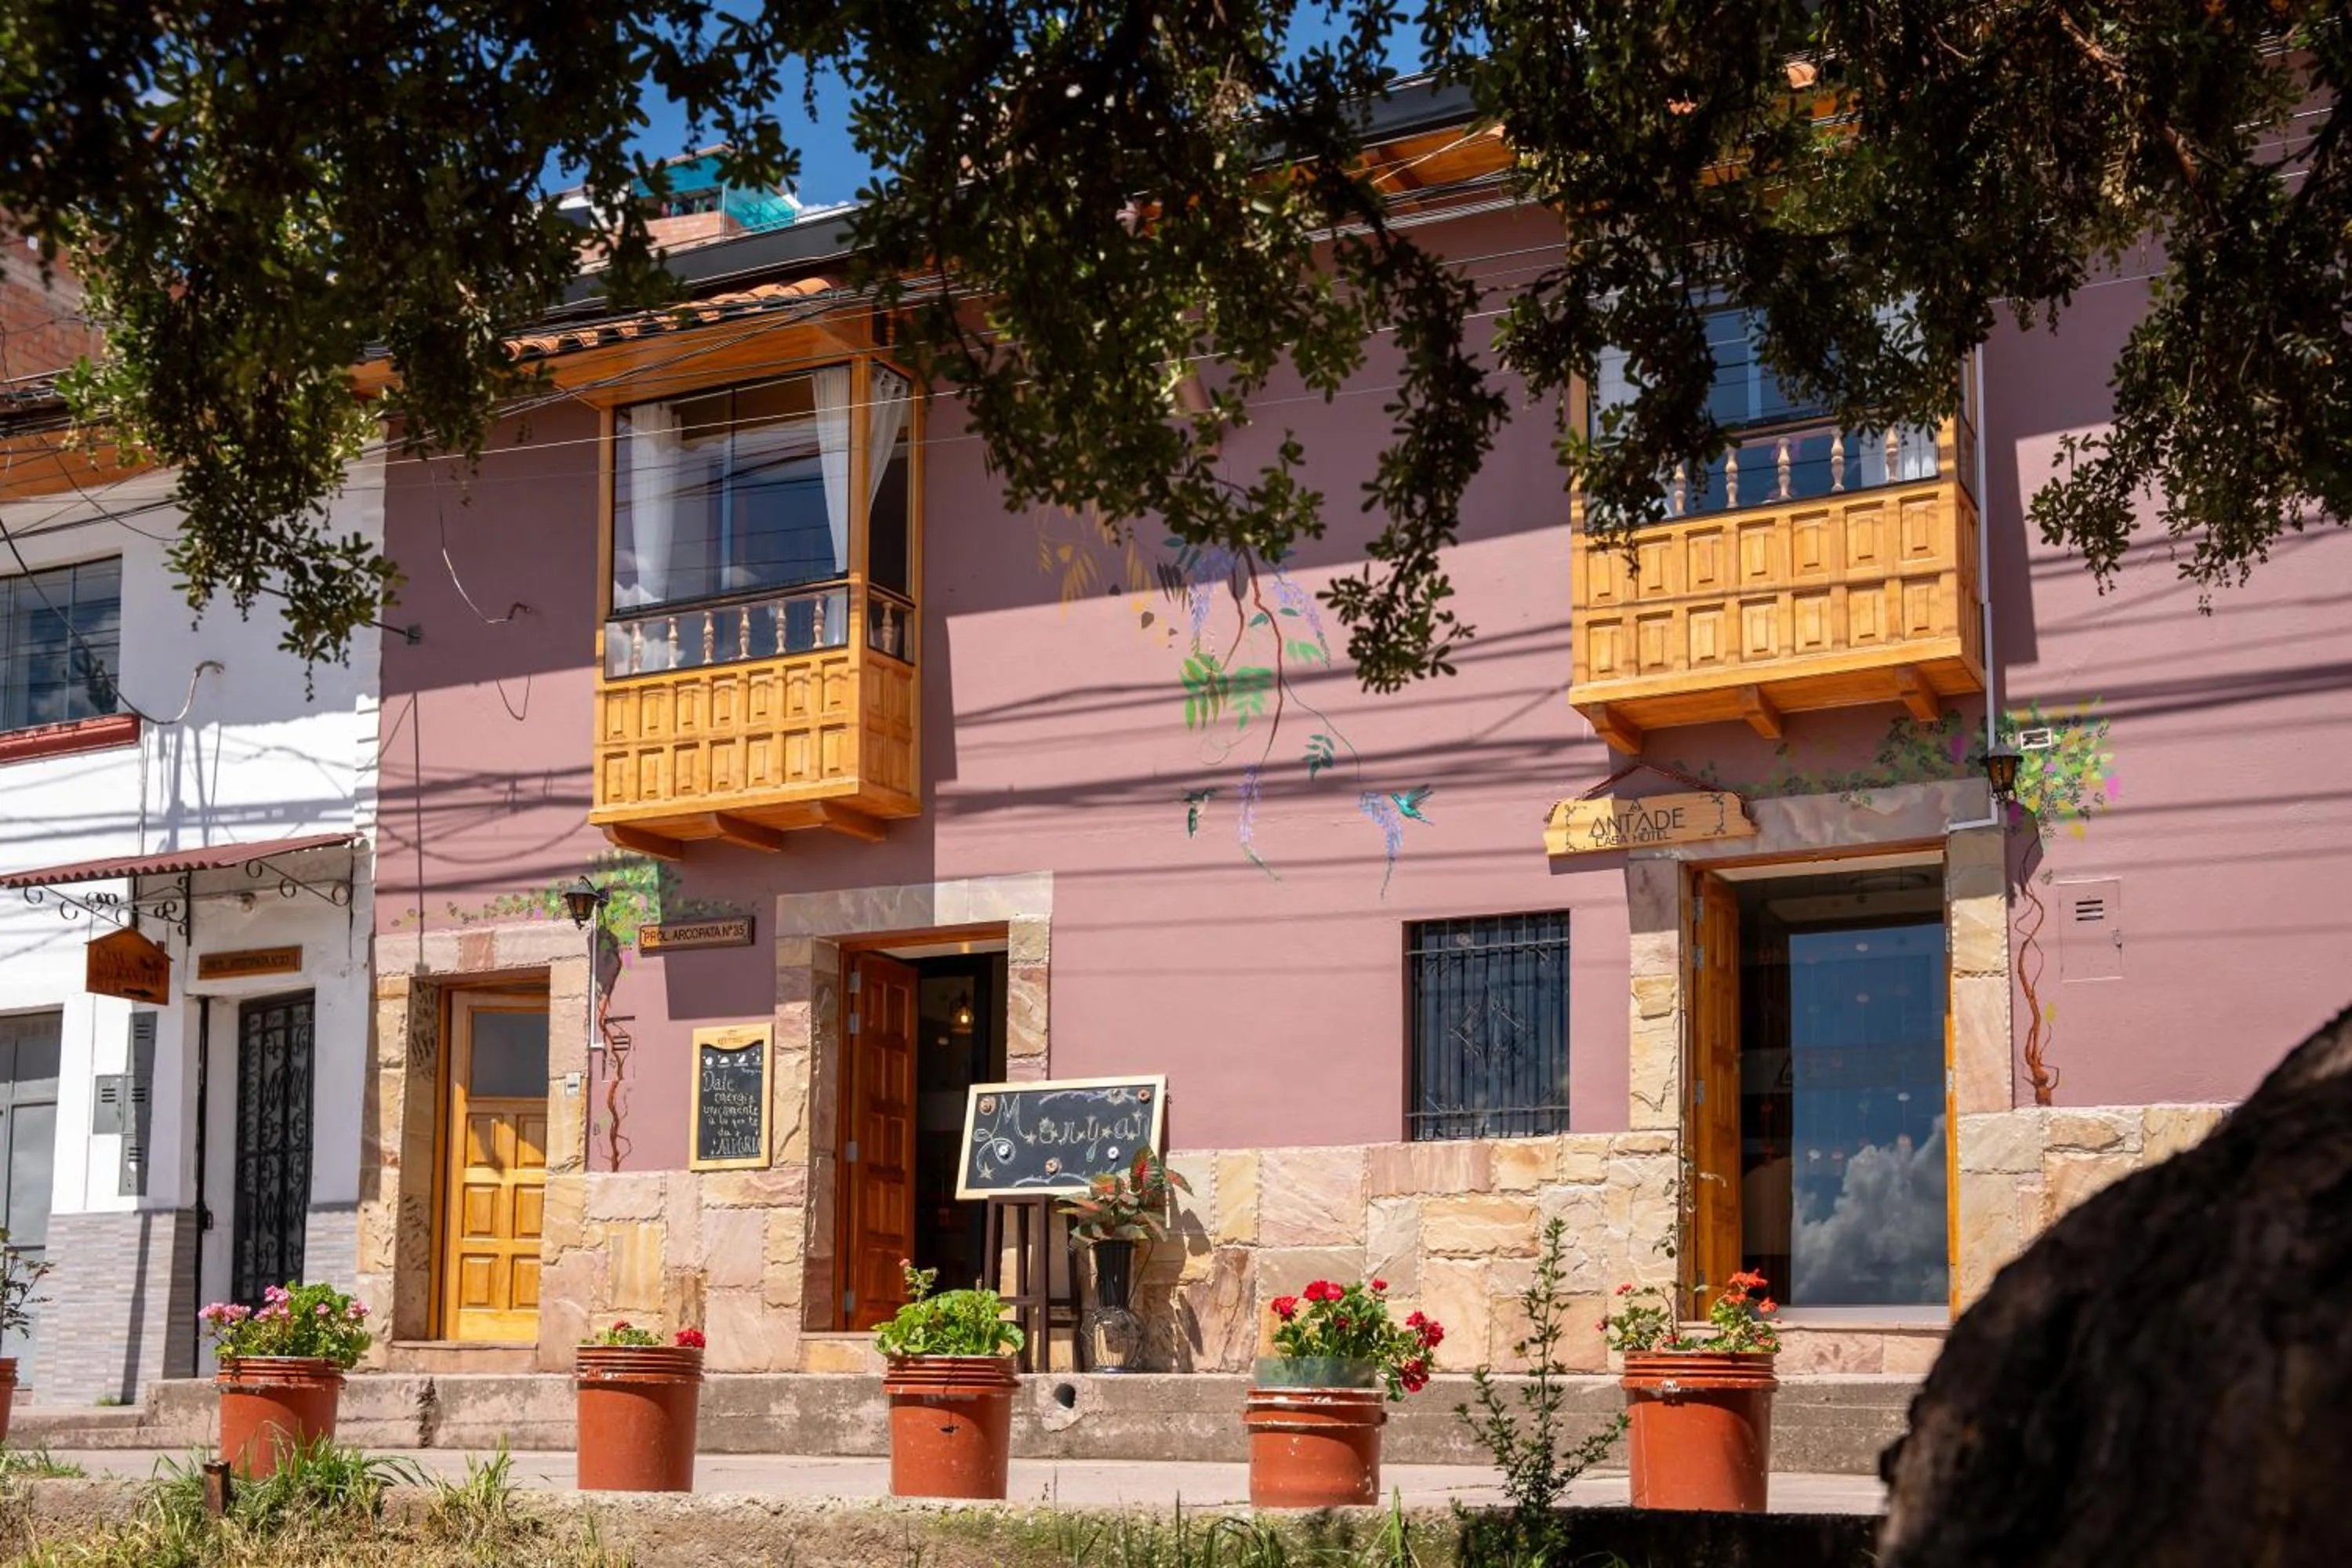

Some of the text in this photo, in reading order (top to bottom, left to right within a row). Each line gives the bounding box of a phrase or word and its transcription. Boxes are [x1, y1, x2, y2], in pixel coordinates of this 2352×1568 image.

[1588, 807, 1686, 837] ANTADE
[1595, 835, 1628, 848] CASA
[673, 927, 720, 941] ARCOPATA
